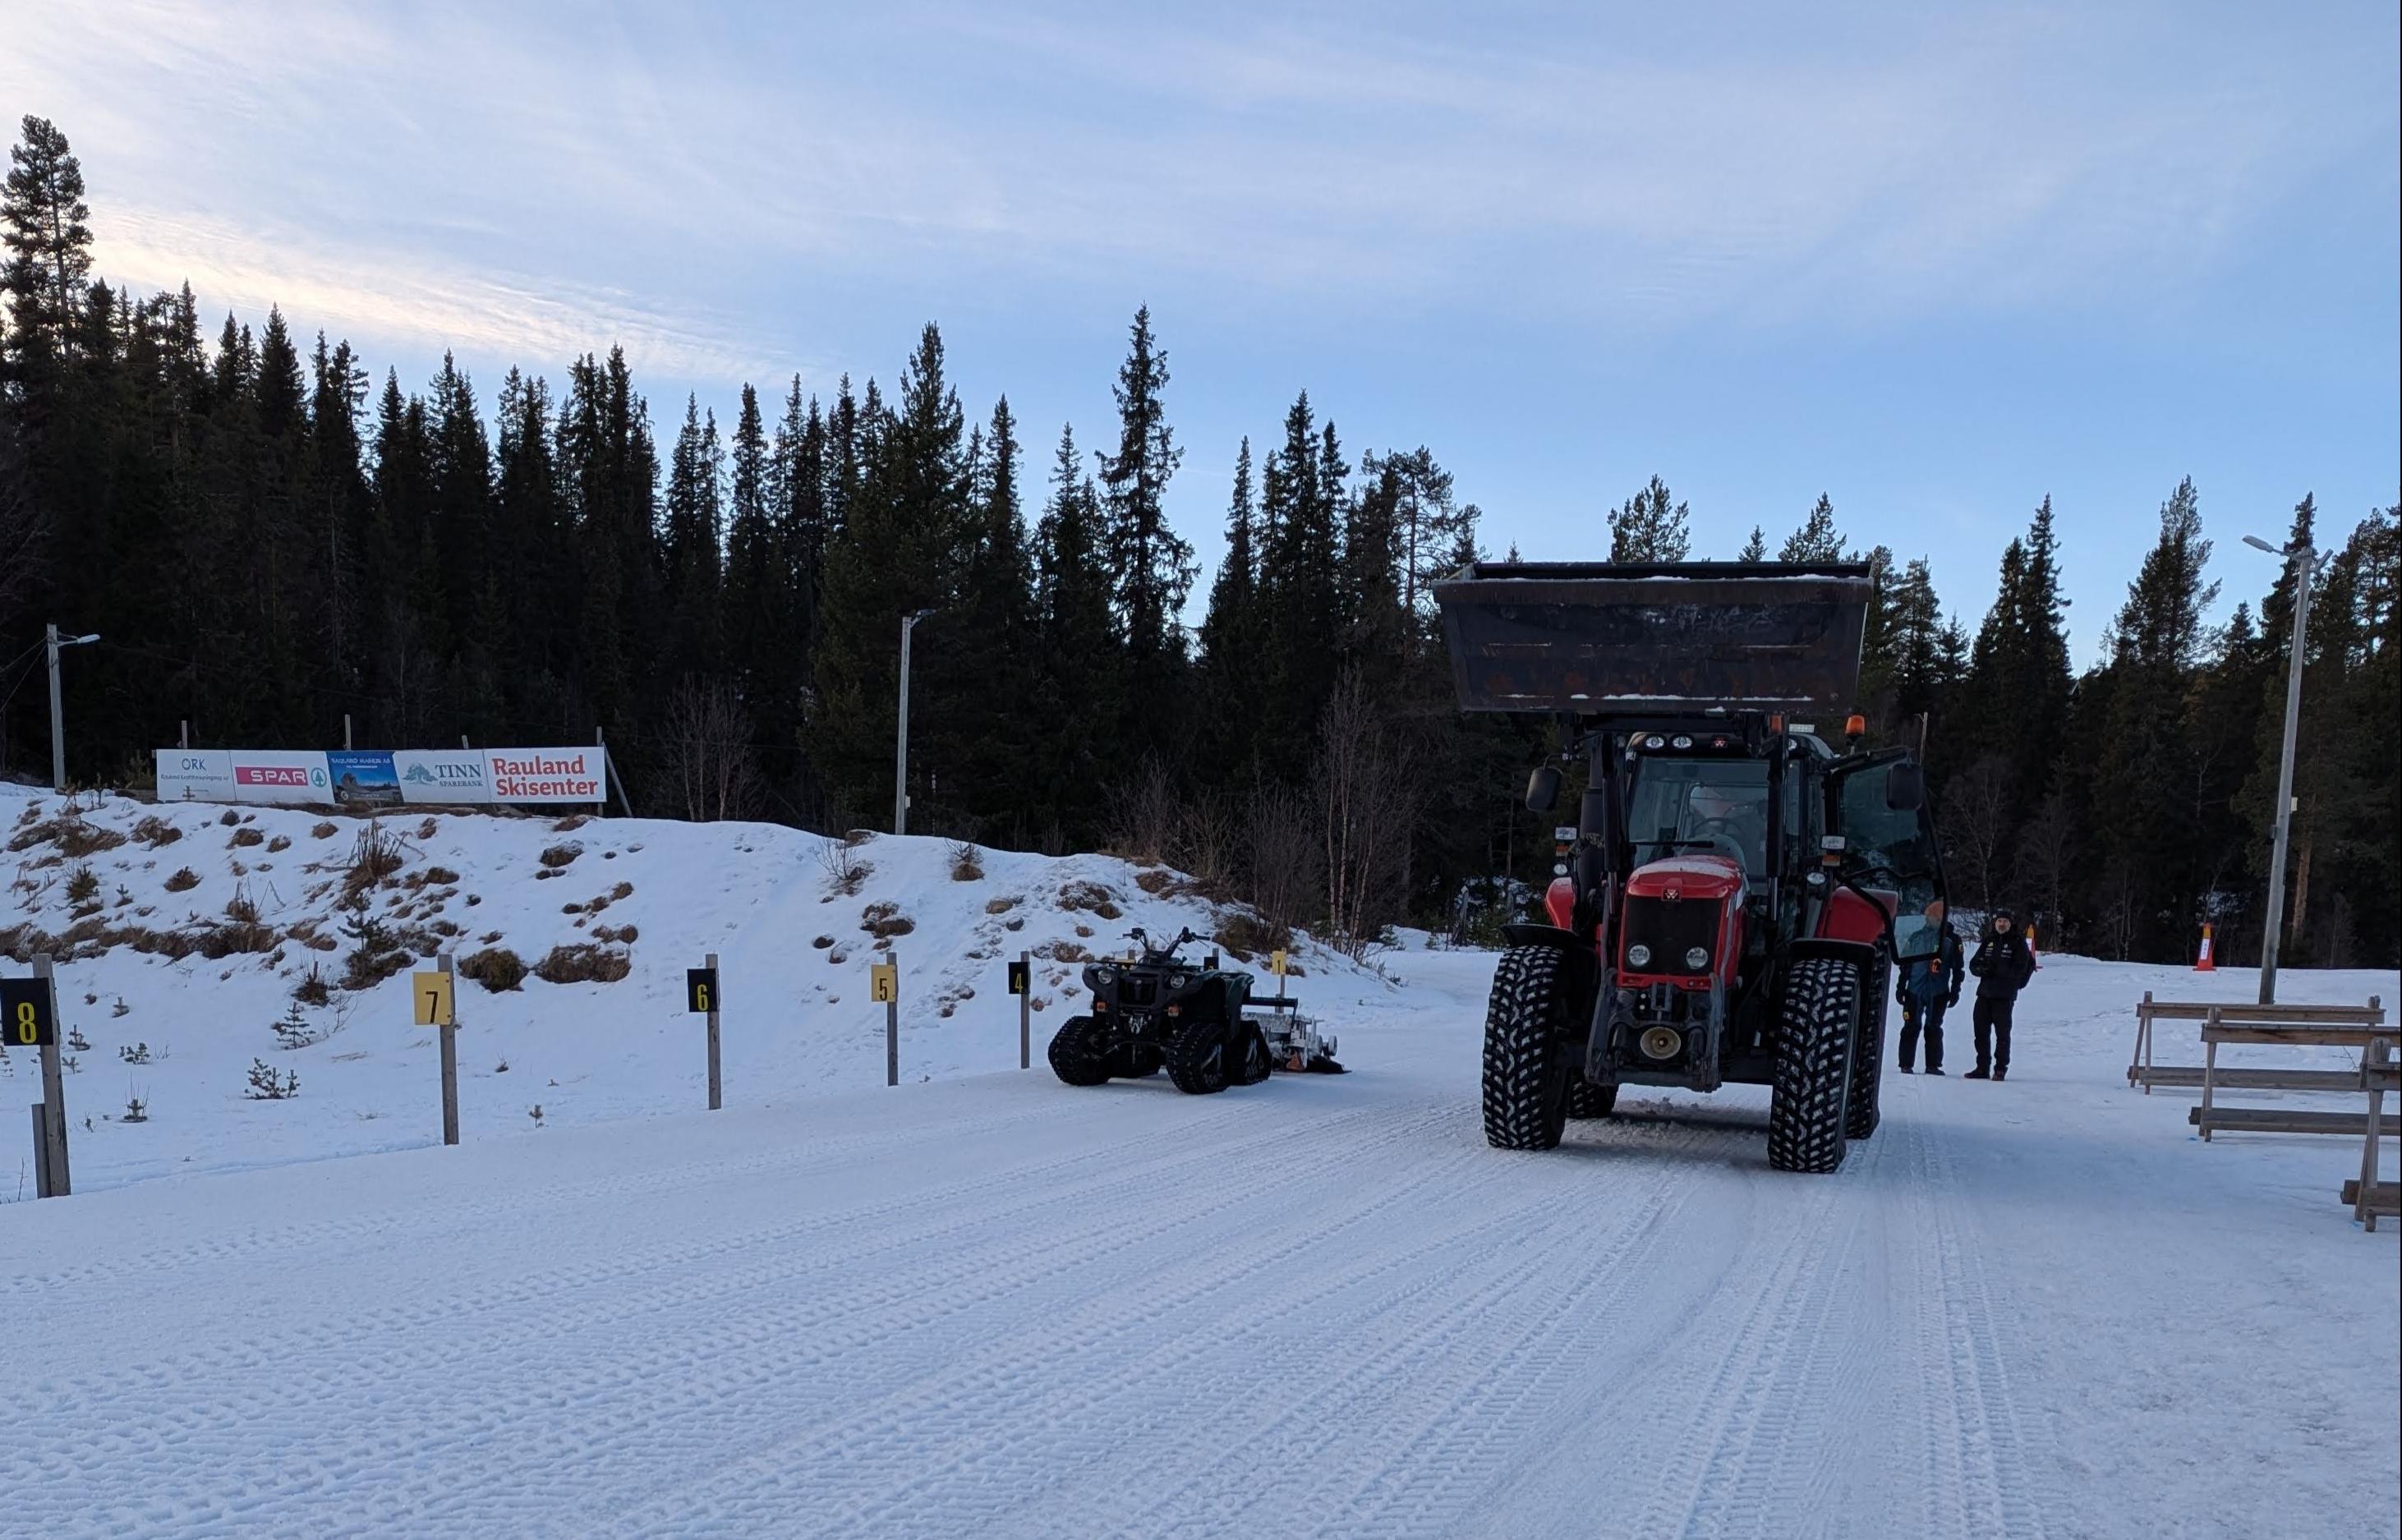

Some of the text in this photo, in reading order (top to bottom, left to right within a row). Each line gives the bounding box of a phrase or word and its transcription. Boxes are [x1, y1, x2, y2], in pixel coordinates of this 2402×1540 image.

[182, 758, 207, 770] ORK
[435, 764, 481, 778] TINN
[491, 754, 586, 775] Rauland
[250, 770, 306, 783] SPAR
[495, 776, 598, 796] Skisenter
[1277, 959, 1281, 974] 1
[879, 977, 888, 1001] 5
[1015, 972, 1024, 993] 4
[426, 991, 439, 1023] 7
[697, 984, 709, 1011] 6
[17, 1002, 37, 1044] 8
